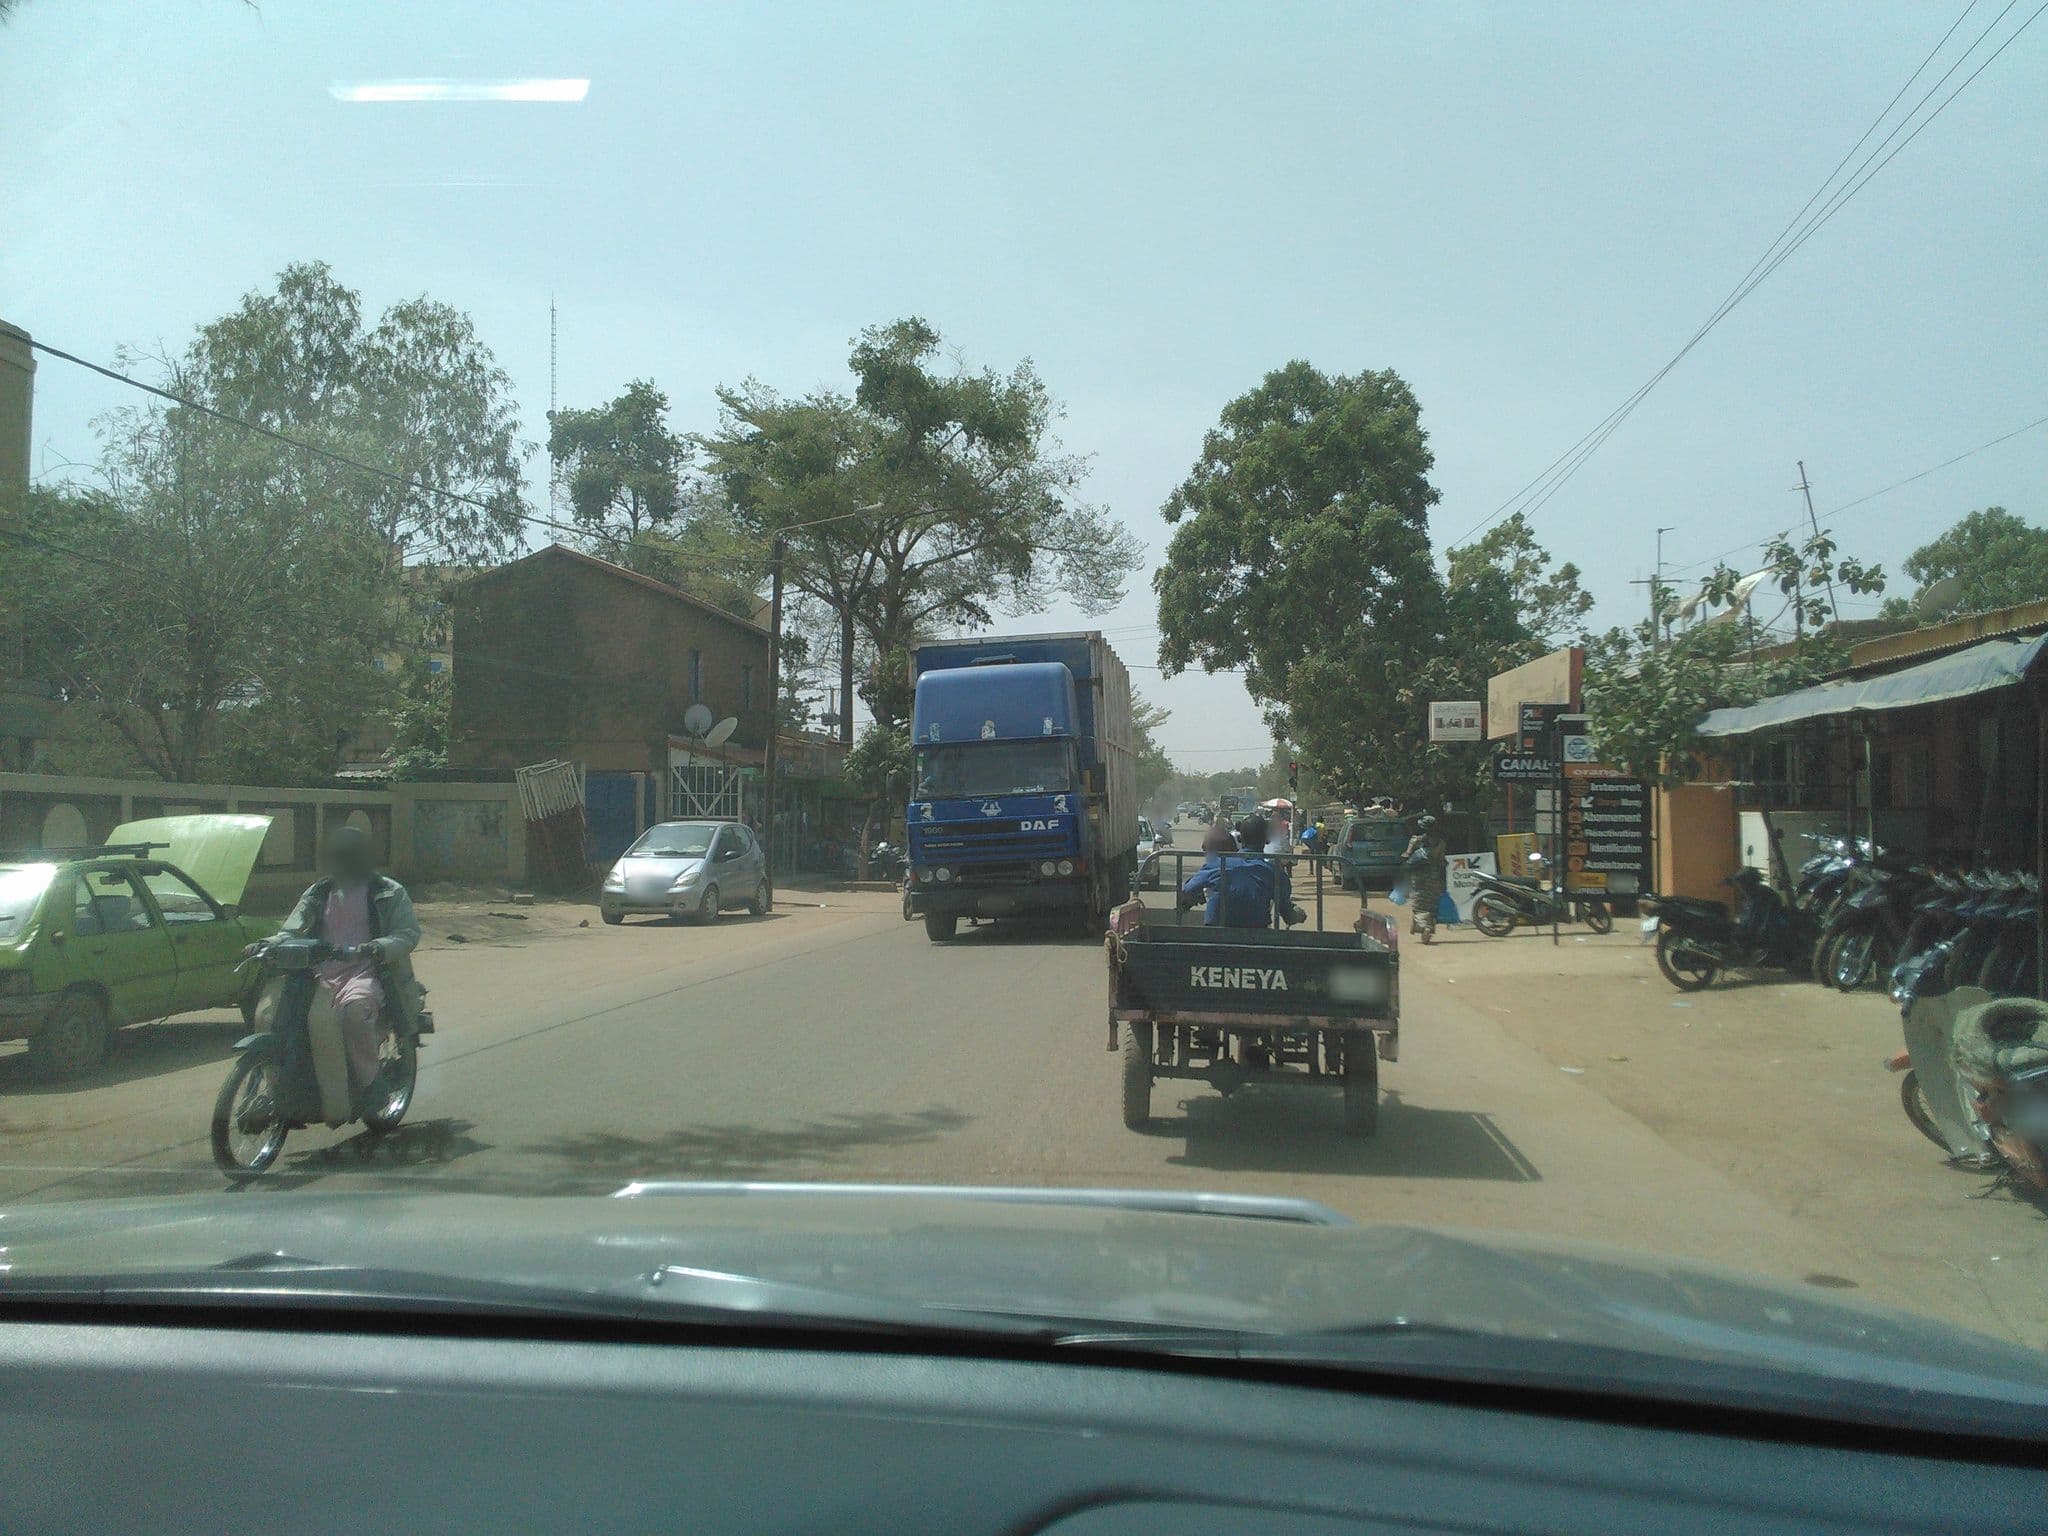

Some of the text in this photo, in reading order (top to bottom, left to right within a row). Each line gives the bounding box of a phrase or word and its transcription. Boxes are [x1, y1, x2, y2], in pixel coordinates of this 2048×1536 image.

[1590, 783, 1642, 792] Internet
[1020, 819, 1060, 831] DAF
[1190, 966, 1289, 991] KENEYA
